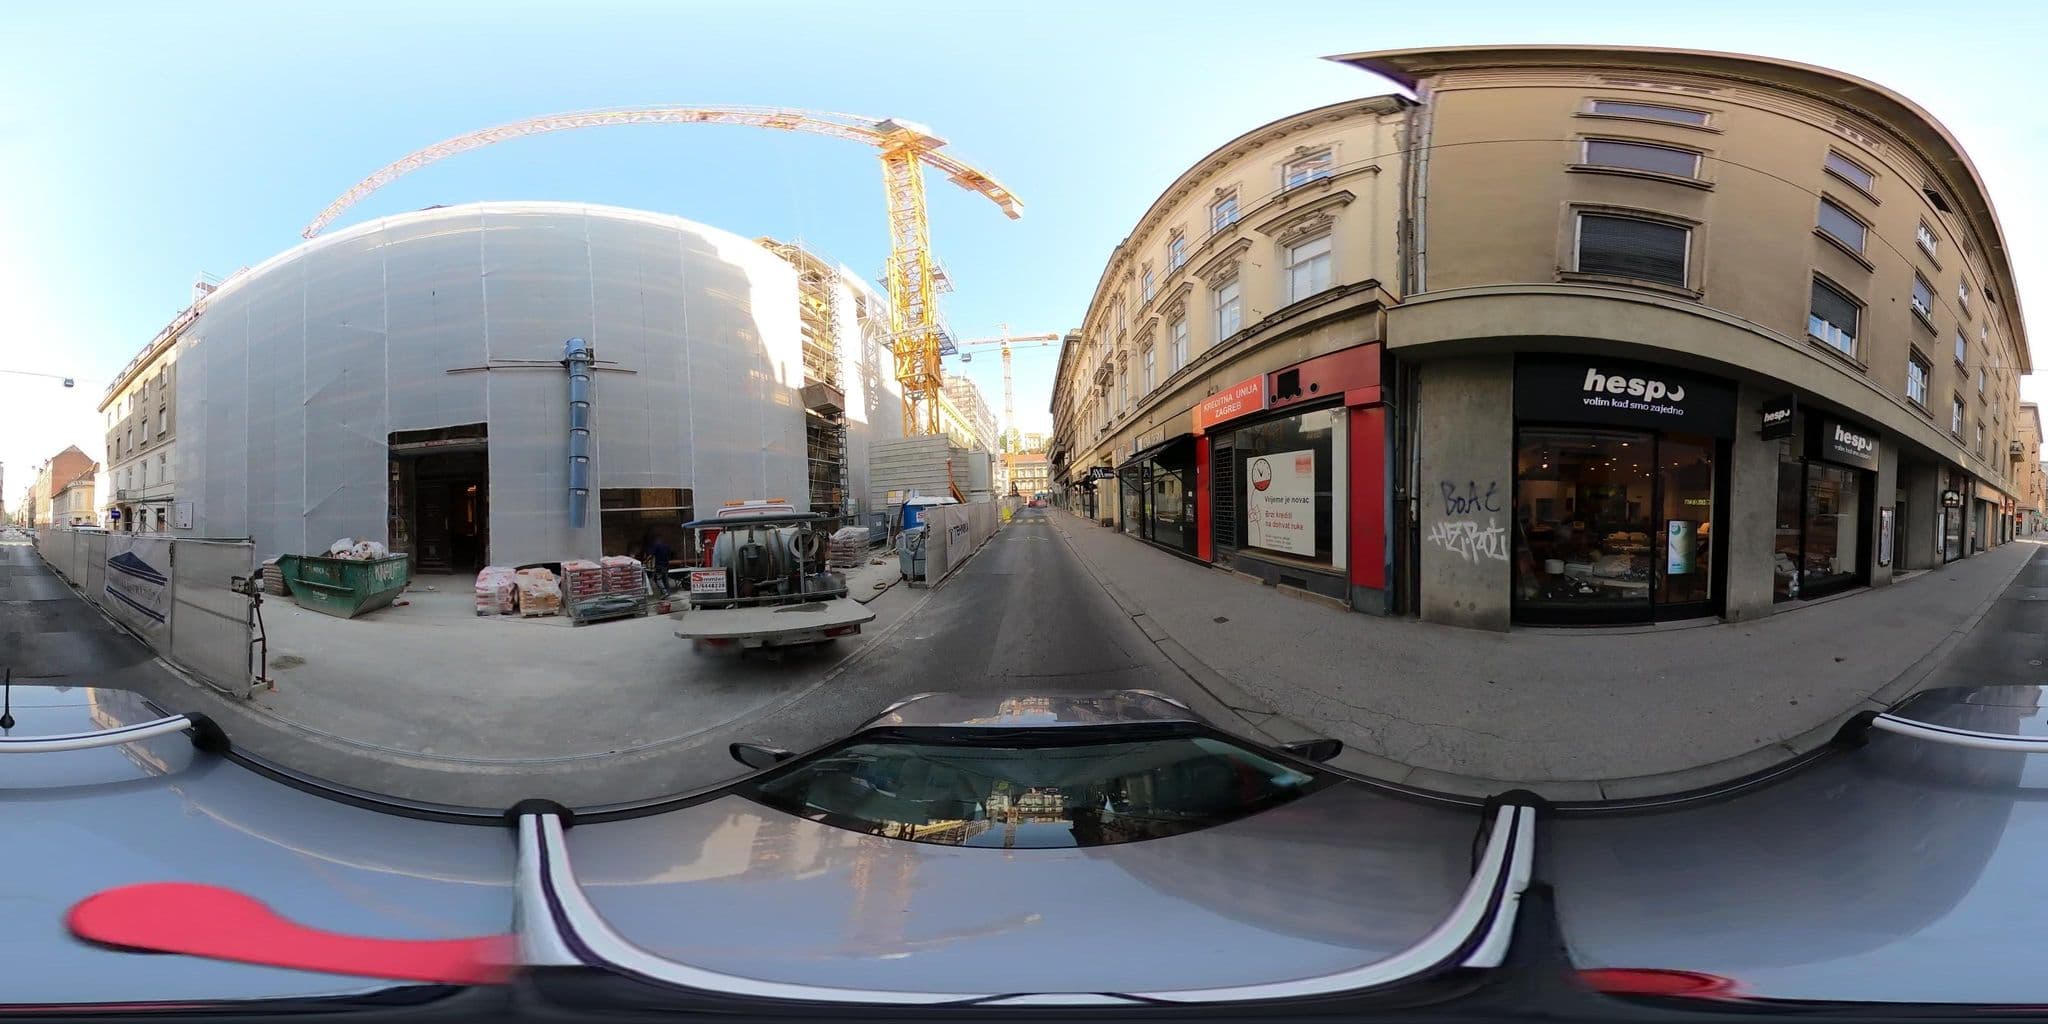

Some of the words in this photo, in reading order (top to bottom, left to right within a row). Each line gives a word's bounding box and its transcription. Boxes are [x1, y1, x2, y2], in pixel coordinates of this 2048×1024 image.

[1203, 393, 1233, 412] KREDITNA
[1235, 383, 1258, 399] UNIJA
[1583, 397, 1610, 407] volim
[1611, 398, 1629, 408] kad
[1629, 402, 1649, 410] smo
[1650, 404, 1684, 416] zajedno
[1215, 401, 1242, 418] ZAGREB
[1264, 495, 1283, 505] Vrijeme
[1284, 496, 1290, 505] je
